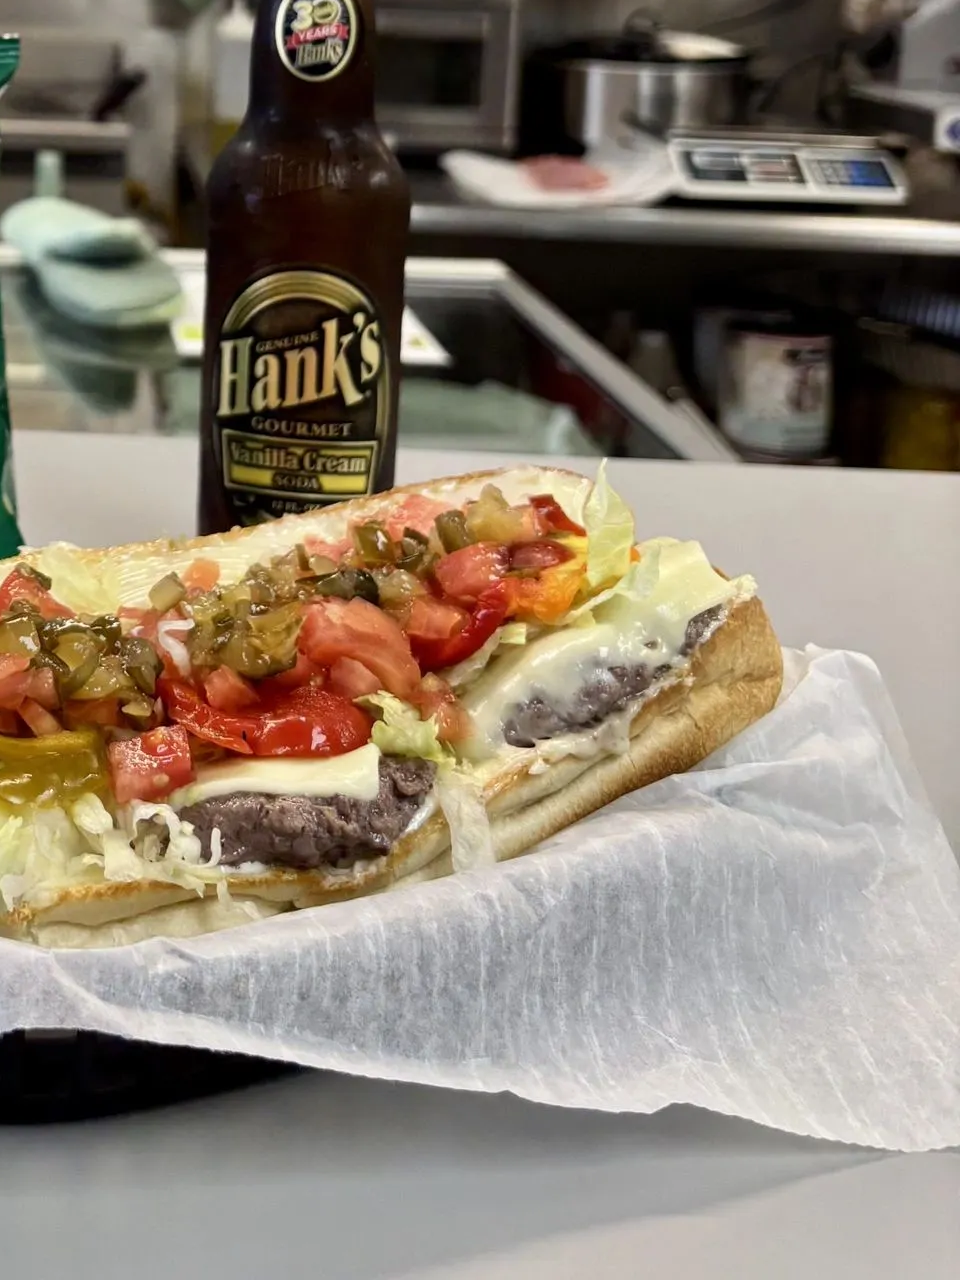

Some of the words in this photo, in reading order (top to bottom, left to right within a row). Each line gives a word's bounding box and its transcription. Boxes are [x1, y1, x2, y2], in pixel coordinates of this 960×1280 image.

[299, 24, 338, 40] YEARS
[256, 332, 319, 353] GENUINE
[216, 312, 382, 417] Hank's
[251, 416, 354, 438] GOURMET
[231, 441, 300, 470] Vanilla
[303, 450, 367, 473] Cream
[275, 473, 320, 490] SODA
